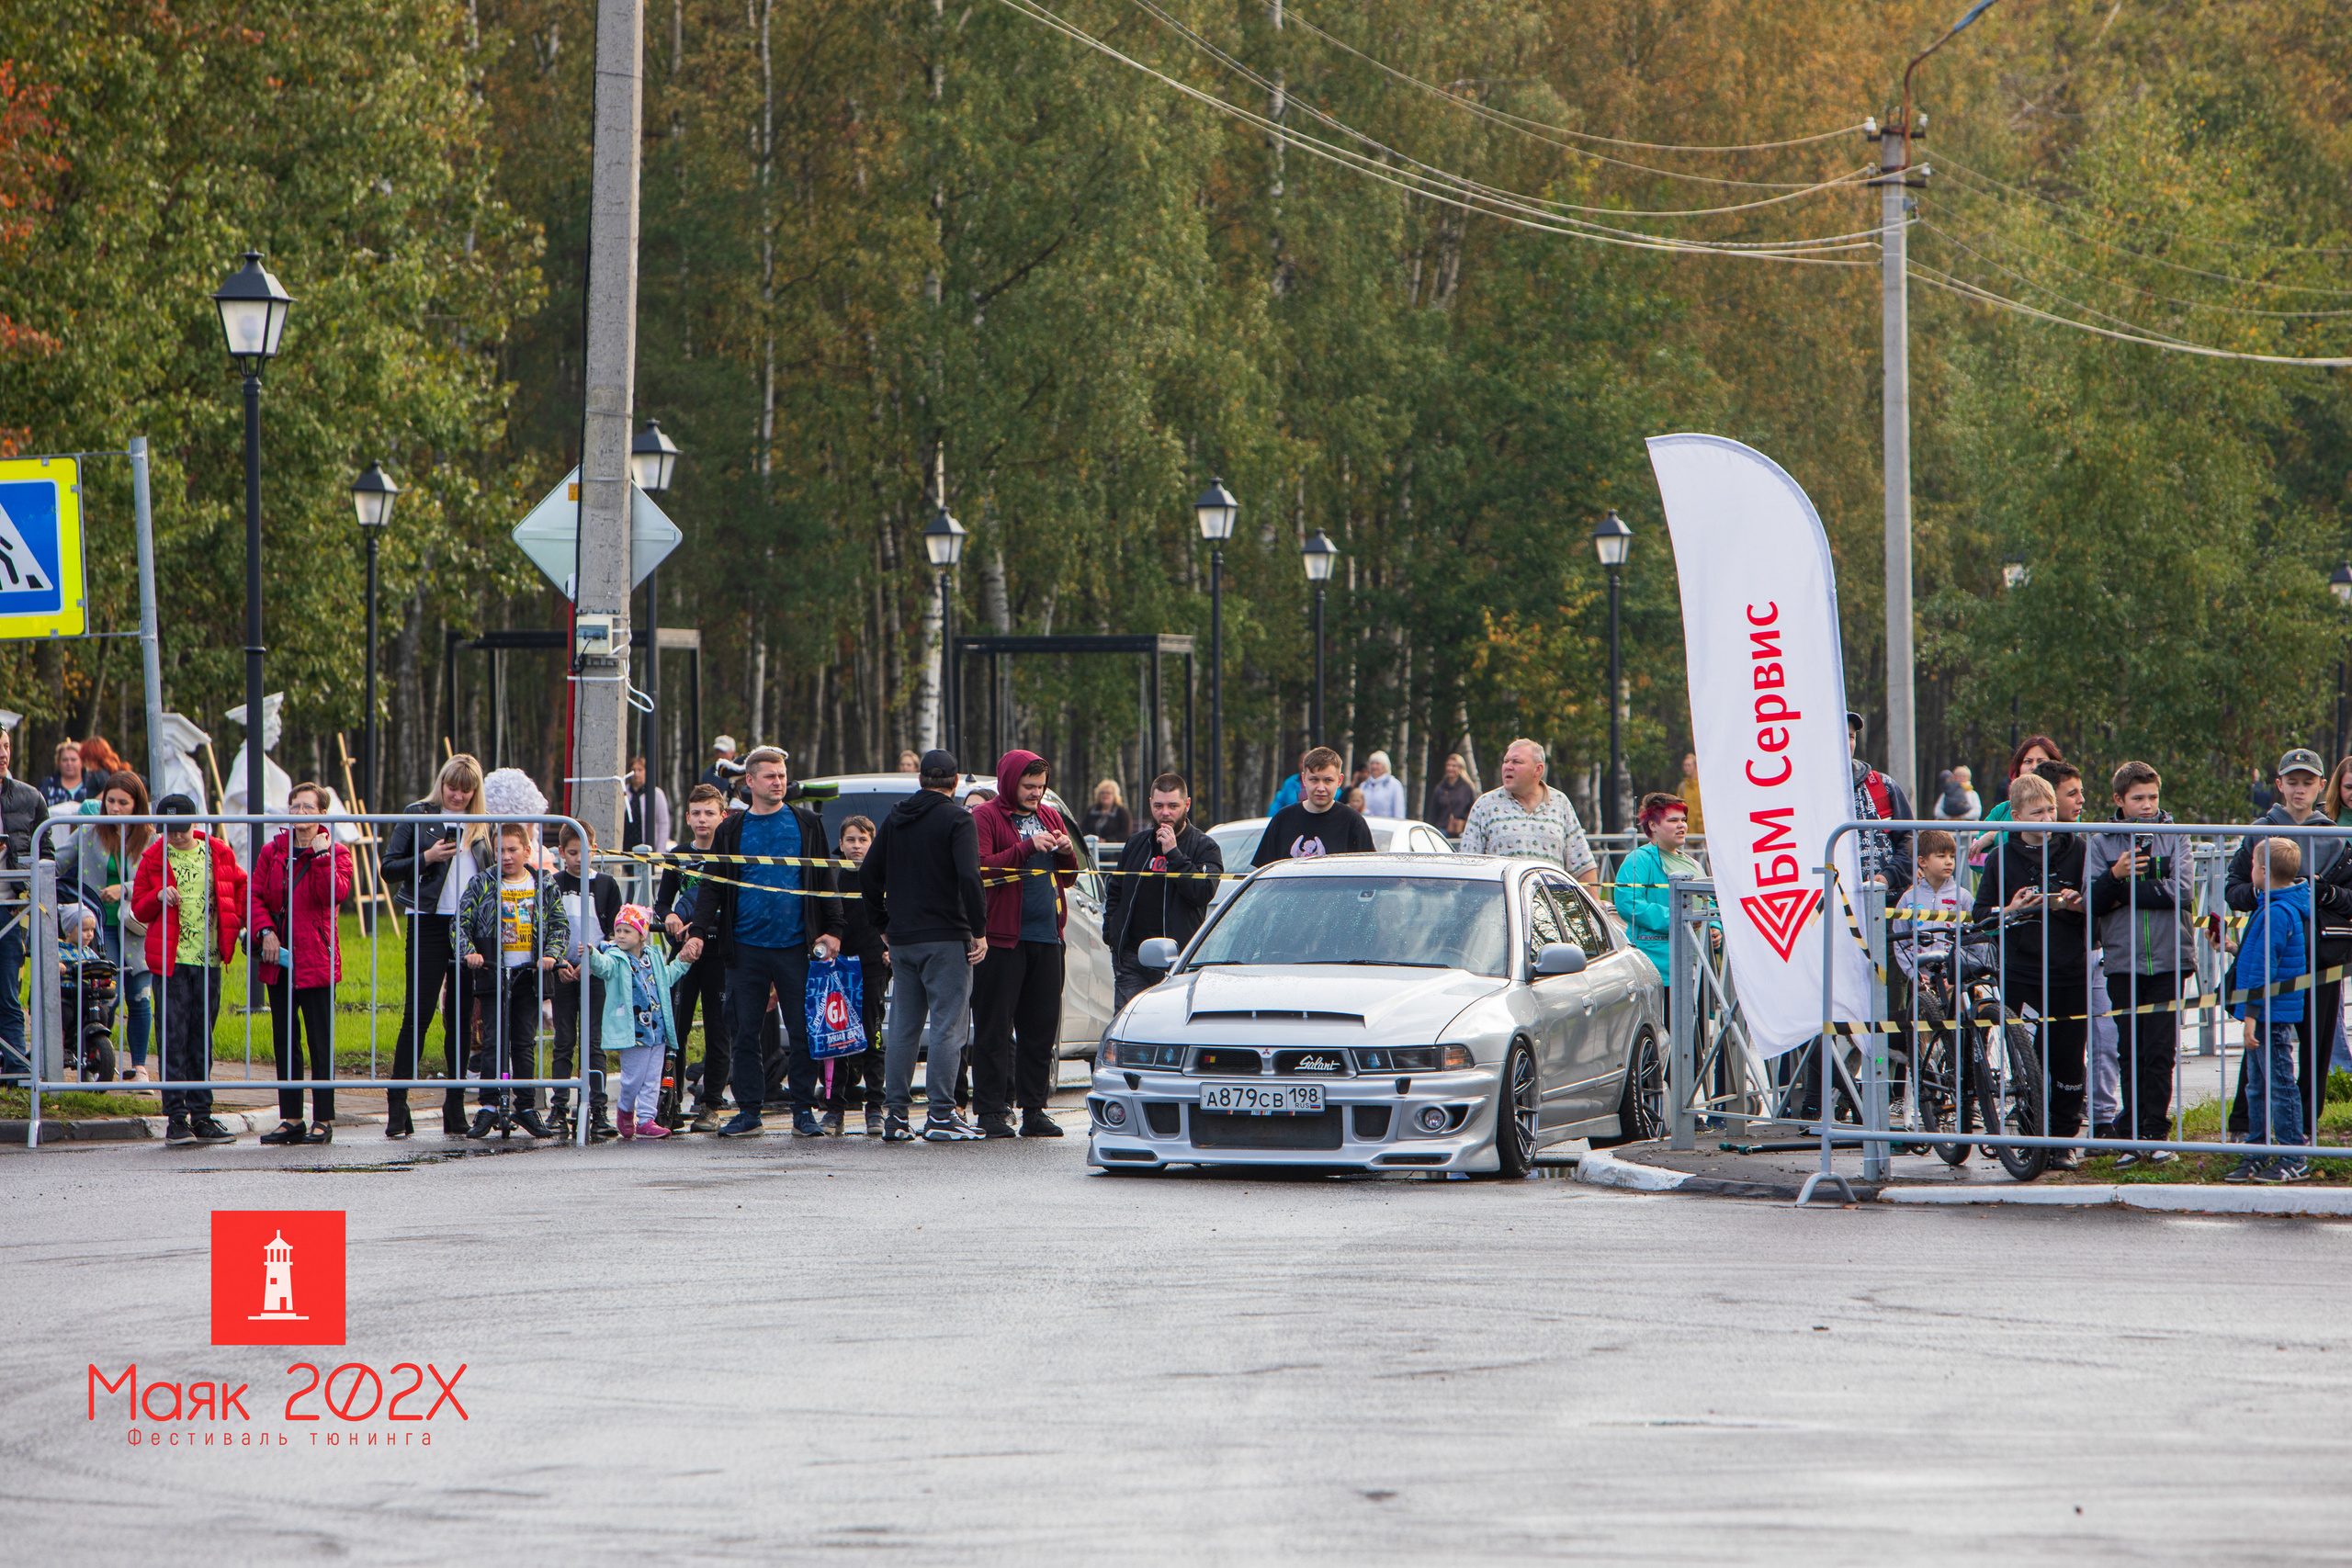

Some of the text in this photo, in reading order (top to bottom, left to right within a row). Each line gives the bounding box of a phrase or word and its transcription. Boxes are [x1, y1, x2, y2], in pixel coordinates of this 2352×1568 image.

[1746, 602, 1801, 887] БМ Сервис
[1295, 1055, 1340, 1071] Galant
[1289, 1088, 1317, 1103] 198
